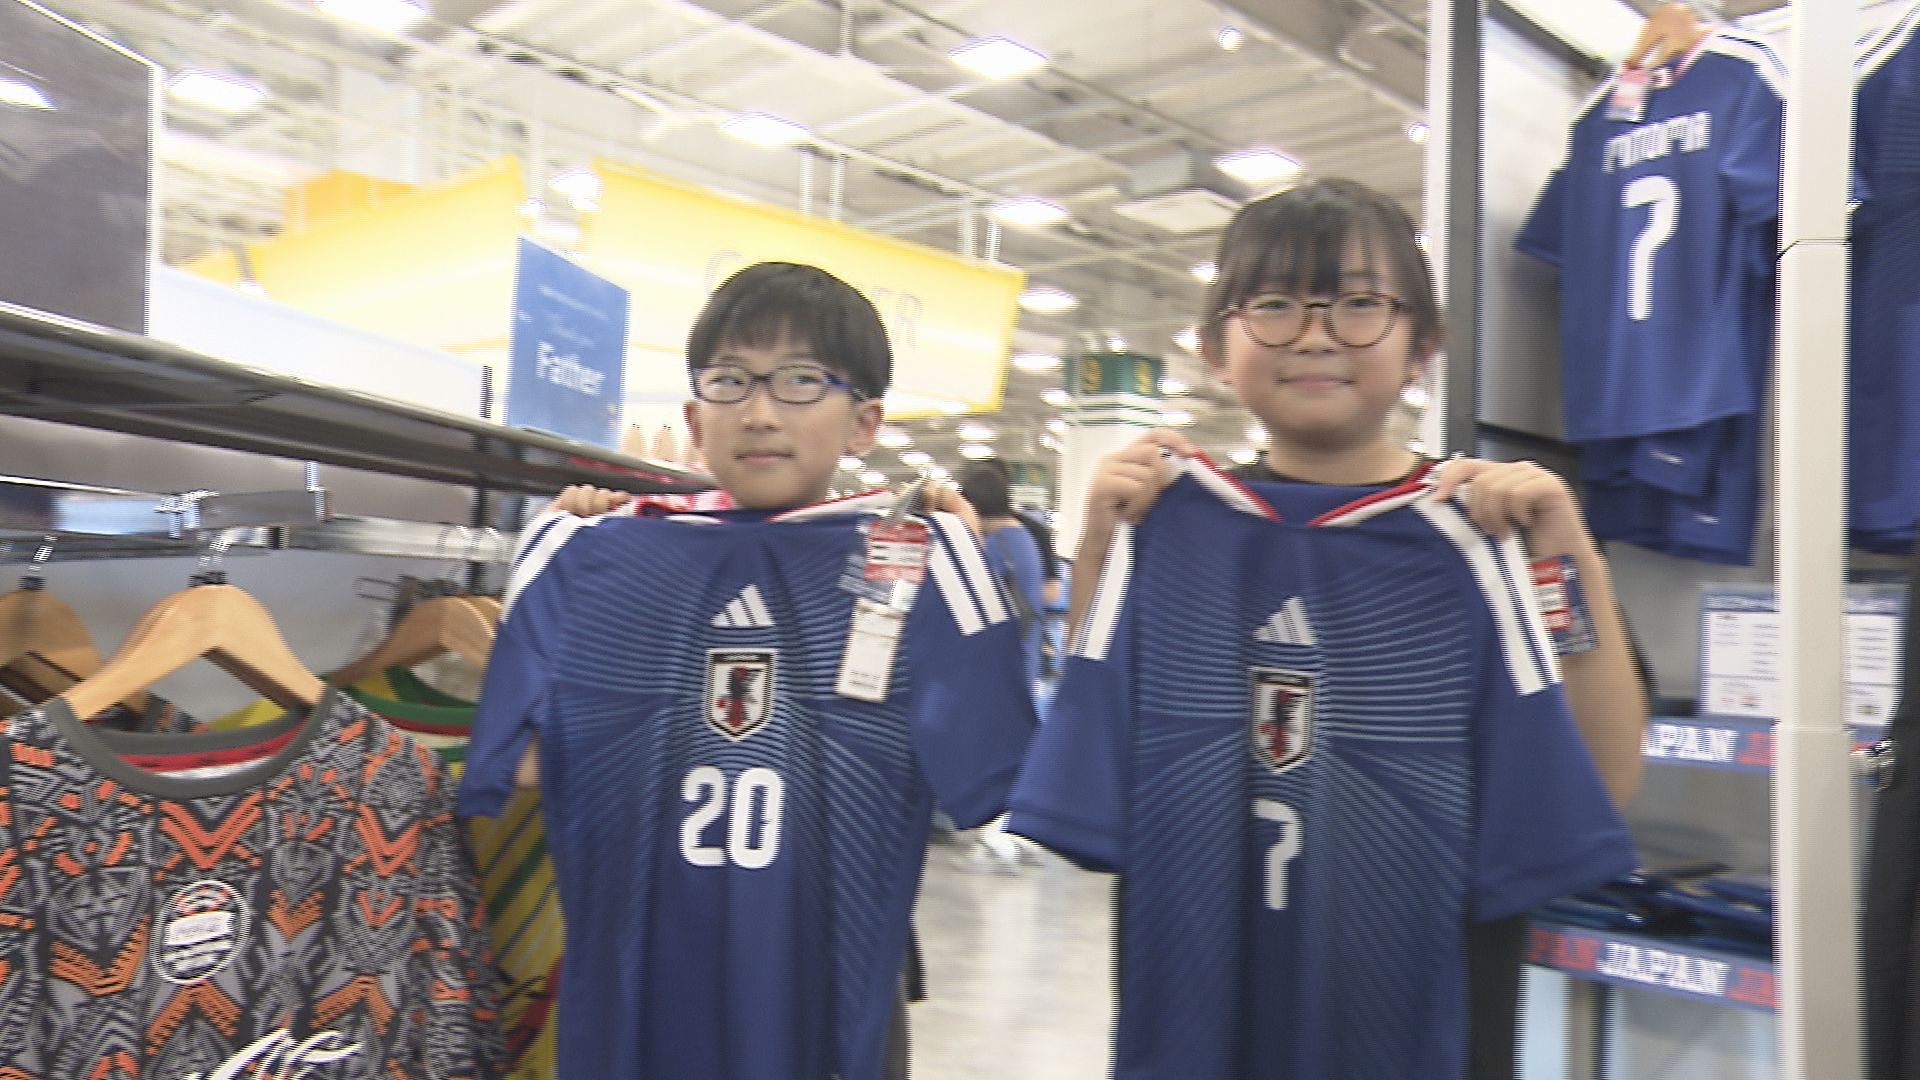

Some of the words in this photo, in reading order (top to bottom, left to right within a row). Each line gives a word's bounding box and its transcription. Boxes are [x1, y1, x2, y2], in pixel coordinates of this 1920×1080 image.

[1602, 111, 1711, 174] MITOMA
[1621, 175, 1681, 321] 7
[536, 341, 606, 396] Father
[681, 766, 784, 869] 20
[1253, 799, 1303, 910] 7
[1597, 942, 1730, 996] JAPAN
